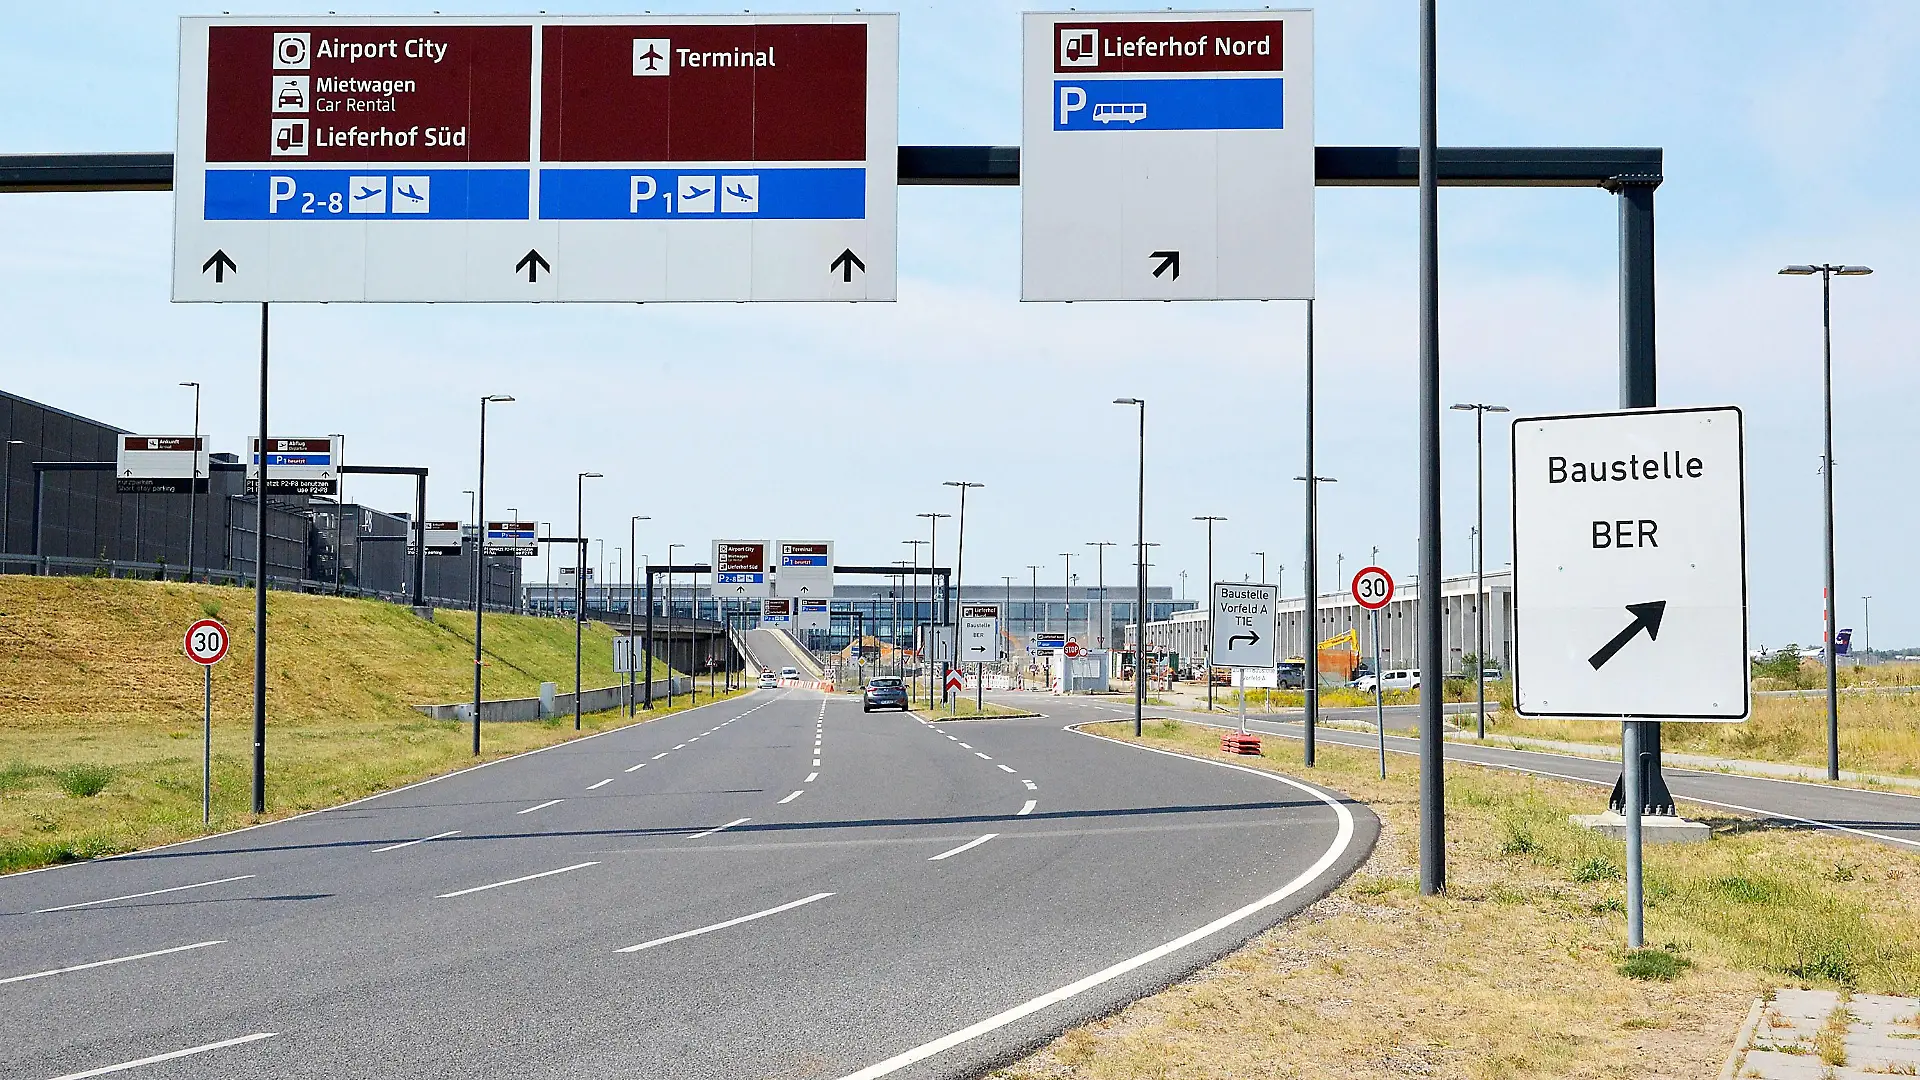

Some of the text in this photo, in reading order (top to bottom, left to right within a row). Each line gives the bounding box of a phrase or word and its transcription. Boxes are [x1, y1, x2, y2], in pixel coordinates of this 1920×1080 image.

[316, 37, 448, 63] Airport City
[675, 46, 776, 67] Terminal
[1104, 35, 1270, 57] Lieferhof Nord
[316, 76, 416, 96] Mietwagen
[316, 97, 396, 112] Car Rental
[1060, 87, 1087, 125] P
[316, 126, 466, 147] Lieferhof Süd
[269, 176, 344, 214] P 2-8
[630, 175, 657, 214] P
[1549, 450, 1703, 484] Baustelle
[1592, 519, 1659, 549] BER
[1221, 588, 1269, 600] Baustelle
[1361, 578, 1385, 597] 30
[1220, 602, 1268, 614] Vorfeld A
[1235, 616, 1253, 626] T1E
[195, 632, 219, 652] 30
[1064, 646, 1078, 654] STOP
